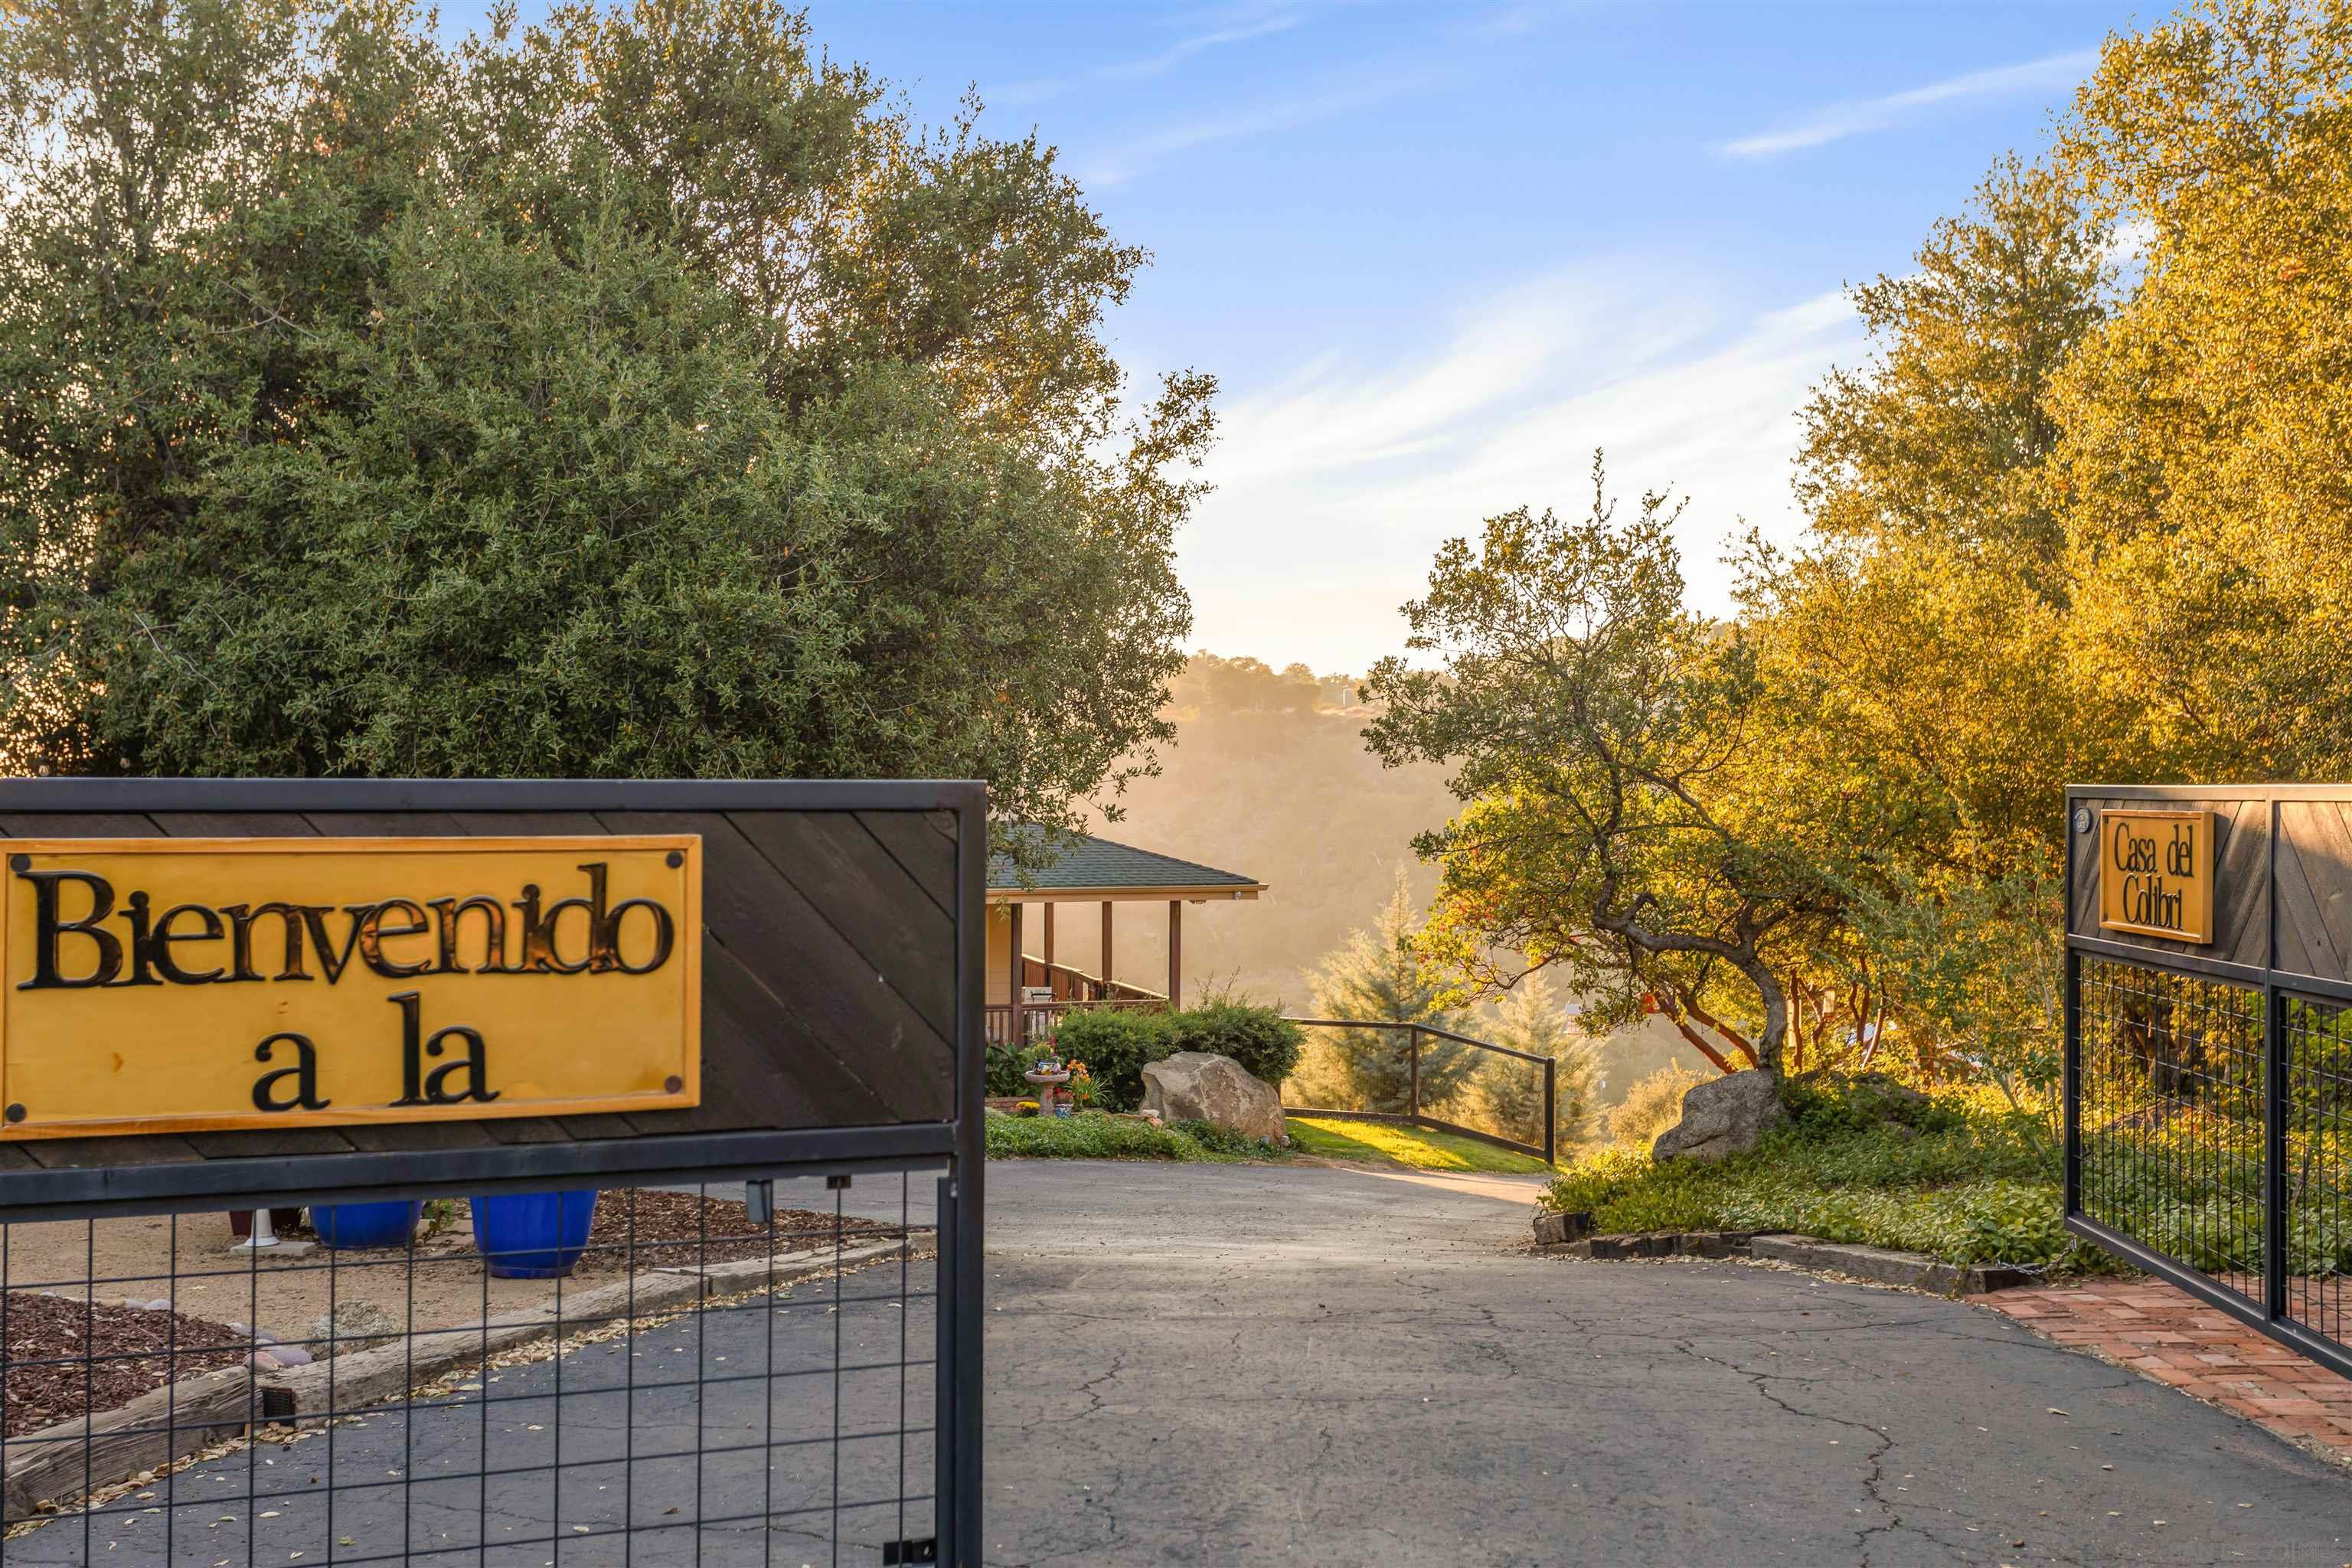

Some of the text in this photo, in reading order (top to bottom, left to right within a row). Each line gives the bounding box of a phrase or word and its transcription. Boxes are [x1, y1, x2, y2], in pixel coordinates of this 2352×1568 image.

[2114, 822, 2194, 878] Casa del
[17, 862, 674, 991] Bienvenido
[252, 991, 500, 1112] a la
